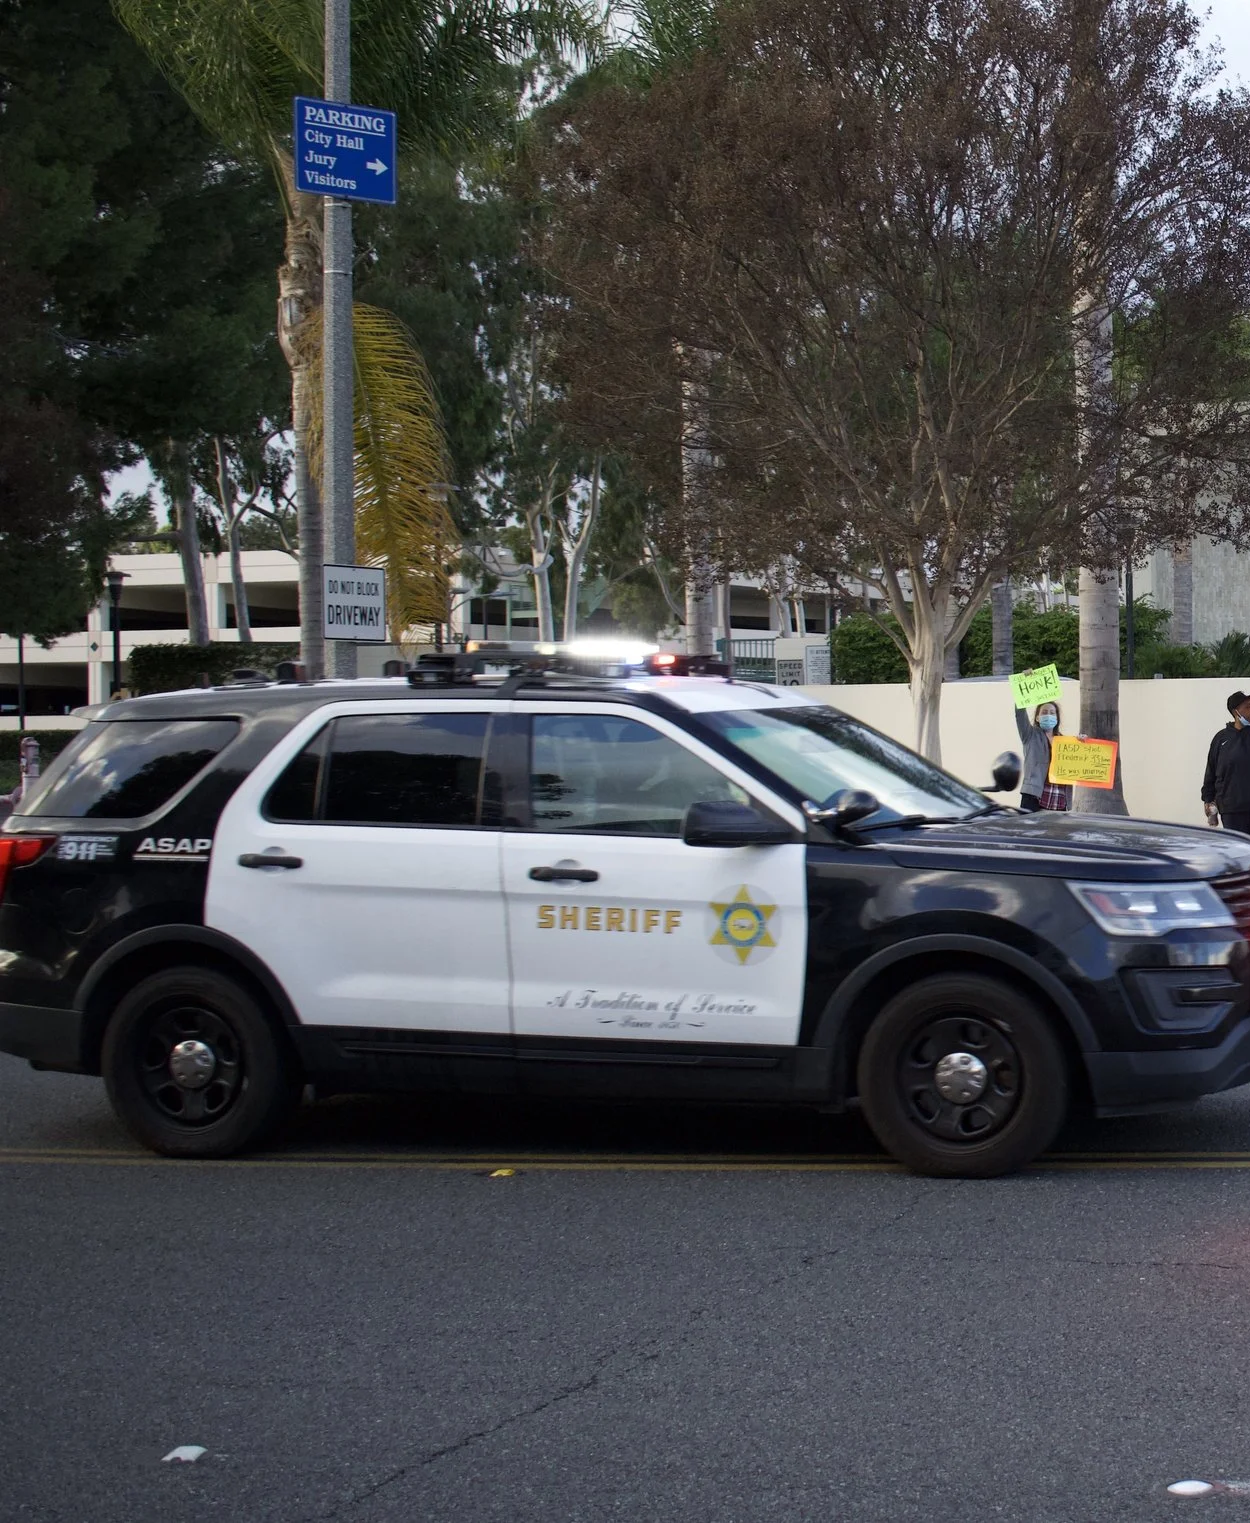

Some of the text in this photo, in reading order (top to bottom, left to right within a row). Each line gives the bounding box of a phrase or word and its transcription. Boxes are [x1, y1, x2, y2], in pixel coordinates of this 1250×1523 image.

[304, 105, 386, 132] PARKING
[304, 129, 364, 150] City Hall
[304, 150, 337, 169] Jury
[304, 170, 357, 190] Visitors
[328, 580, 379, 596] DO NOT BLOCK
[328, 604, 381, 627] DRIVEWAY
[779, 662, 803, 670] SPEED
[1018, 670, 1058, 696] HONK!
[136, 837, 212, 852] ASAP
[537, 904, 684, 934] SHERIFF
